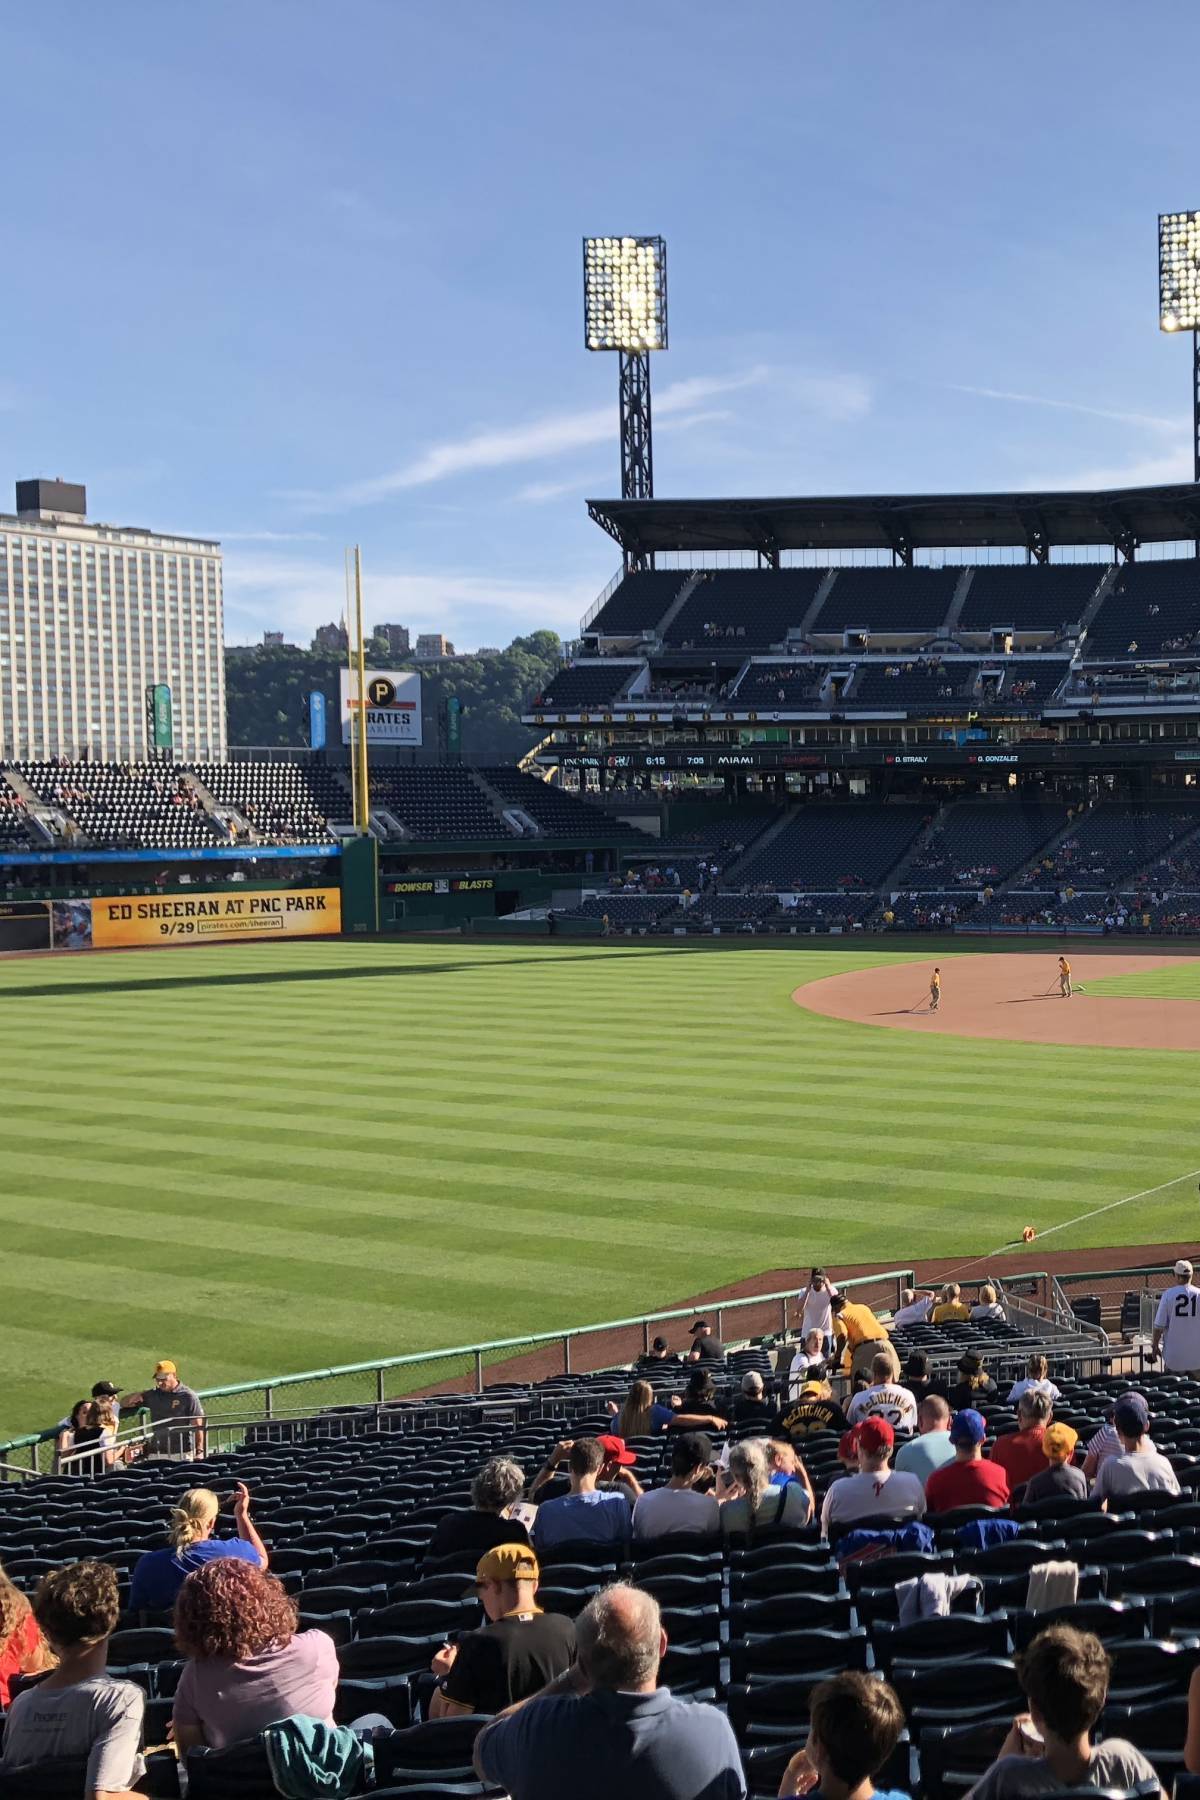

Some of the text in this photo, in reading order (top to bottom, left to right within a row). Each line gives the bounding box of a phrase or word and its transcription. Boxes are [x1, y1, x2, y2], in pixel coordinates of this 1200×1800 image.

[352, 712, 411, 725] PRATES
[646, 756, 666, 765] 6:15
[717, 756, 754, 764] MIAMI
[394, 882, 433, 893] BOWSER
[458, 879, 494, 890] BLASTS
[108, 895, 327, 921] ED SHEERAN AT PNC PARK
[160, 918, 281, 936] 9/29 pirates.com/sheeran
[1175, 1293, 1197, 1317] 21
